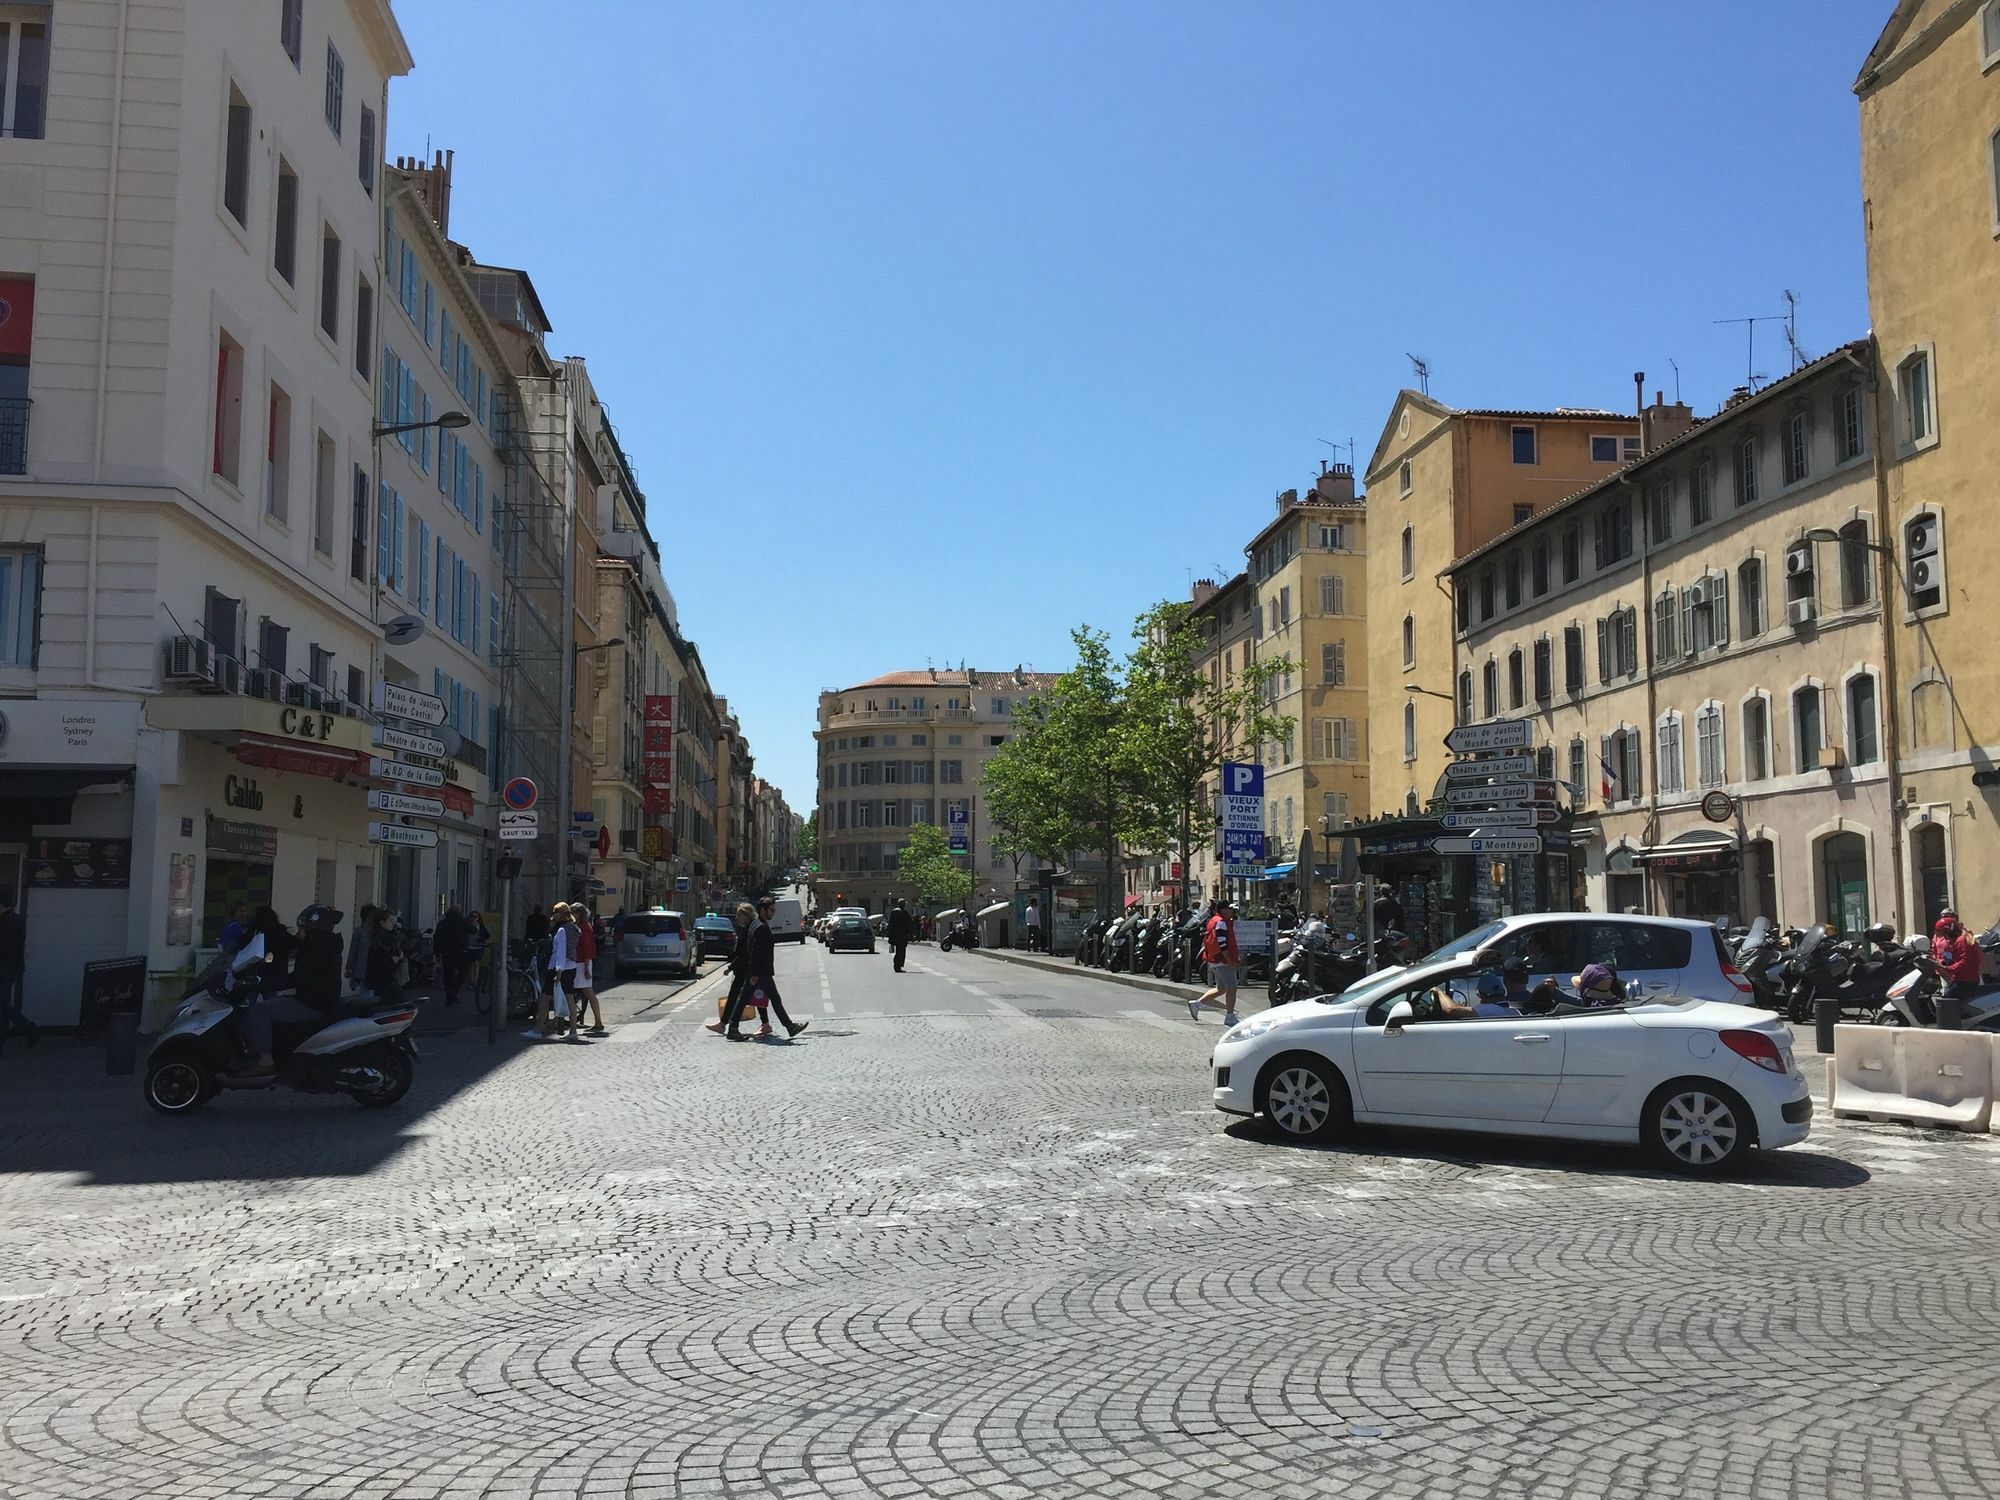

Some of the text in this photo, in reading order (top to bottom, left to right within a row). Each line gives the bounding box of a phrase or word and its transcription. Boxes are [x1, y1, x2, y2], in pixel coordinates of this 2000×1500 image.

[388, 689, 440, 710] Palais de Justice
[387, 702, 433, 720] Musée Cantini
[62, 715, 96, 724] Londres
[281, 708, 334, 740] C & F
[63, 726, 94, 736] Sydney
[1455, 731, 1476, 740] Palais
[1494, 725, 1522, 735] Justice
[68, 738, 88, 746] Paris
[410, 740, 417, 748] de
[420, 742, 425, 750] la
[428, 743, 442, 754] Criée
[1464, 736, 1522, 748] Musée Cantini
[1504, 762, 1523, 770] Criée
[407, 770, 414, 778] de
[416, 770, 422, 780] la
[424, 772, 441, 784] Garde
[1234, 767, 1254, 792] P
[225, 774, 263, 810] Caldo
[1503, 788, 1524, 796] Garde
[1228, 796, 1260, 805] VIEUX
[293, 795, 304, 818] &
[1230, 805, 1258, 813] PORT
[954, 812, 963, 822] P
[1228, 814, 1260, 822] ESTIENNE
[1485, 841, 1535, 850] Monthyon
[1228, 865, 1260, 874] OUVERT
